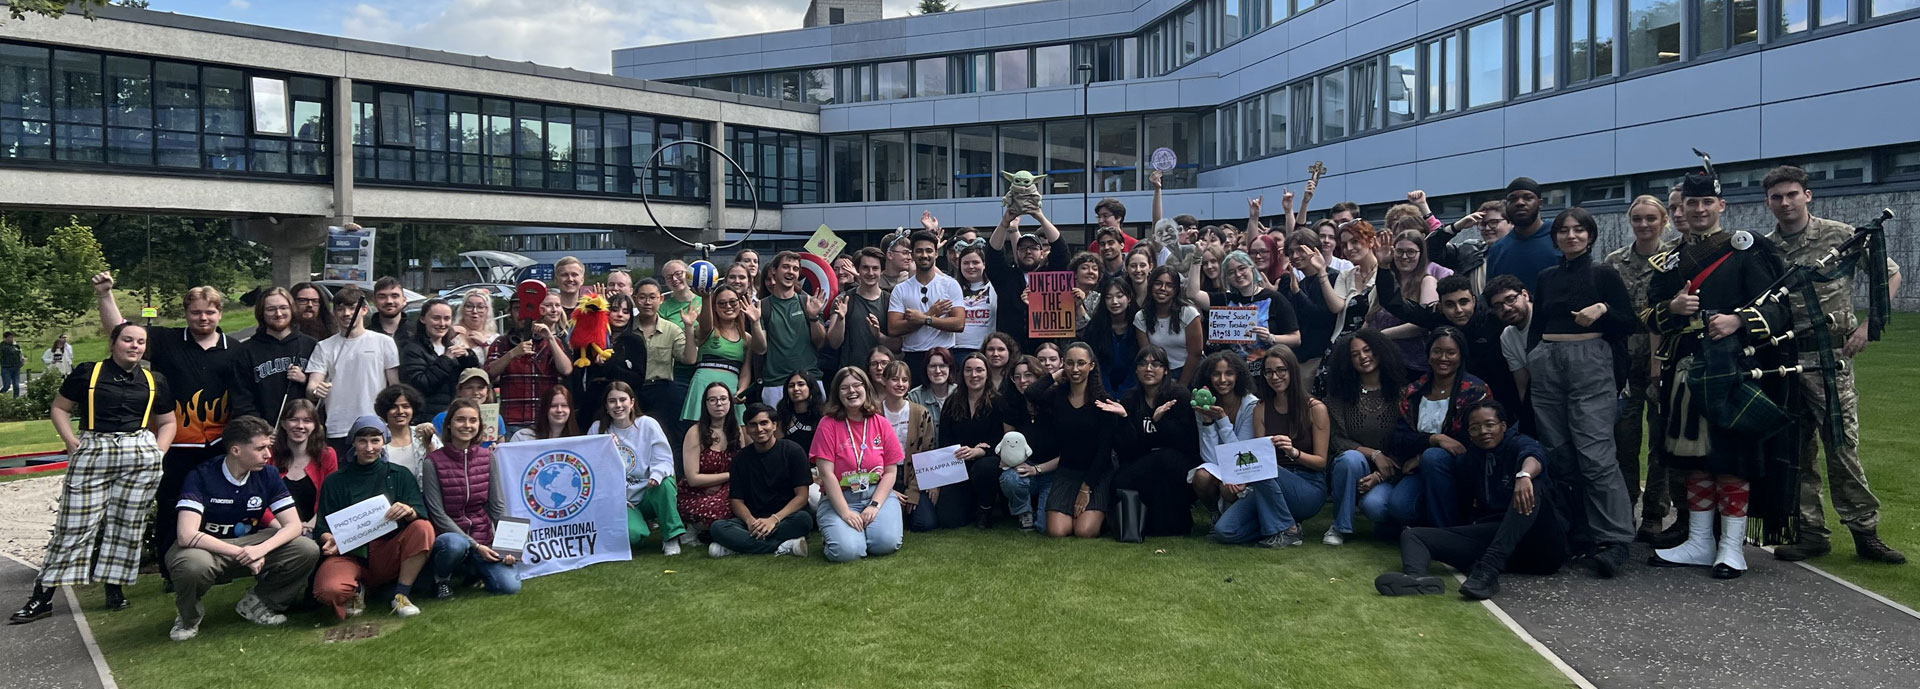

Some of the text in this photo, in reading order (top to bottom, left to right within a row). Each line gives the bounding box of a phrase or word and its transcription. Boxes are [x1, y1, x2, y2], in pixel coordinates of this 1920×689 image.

[1030, 273, 1073, 293] UNFUCK
[1041, 292, 1062, 311] THE
[965, 309, 990, 320] LICE
[1032, 310, 1072, 330] WORLD
[1233, 311, 1251, 321] Society
[1229, 320, 1248, 329] Tuesday
[915, 467, 930, 475] ZETA
[930, 462, 950, 472] KAPPA
[333, 504, 387, 530] PHOTOGRAPHY
[356, 520, 371, 530] AND
[205, 522, 234, 535] BT
[341, 521, 390, 545] VIDEOGRAPHY
[527, 521, 597, 543] NTERNATIONAL
[526, 533, 597, 564] SOCIETY
